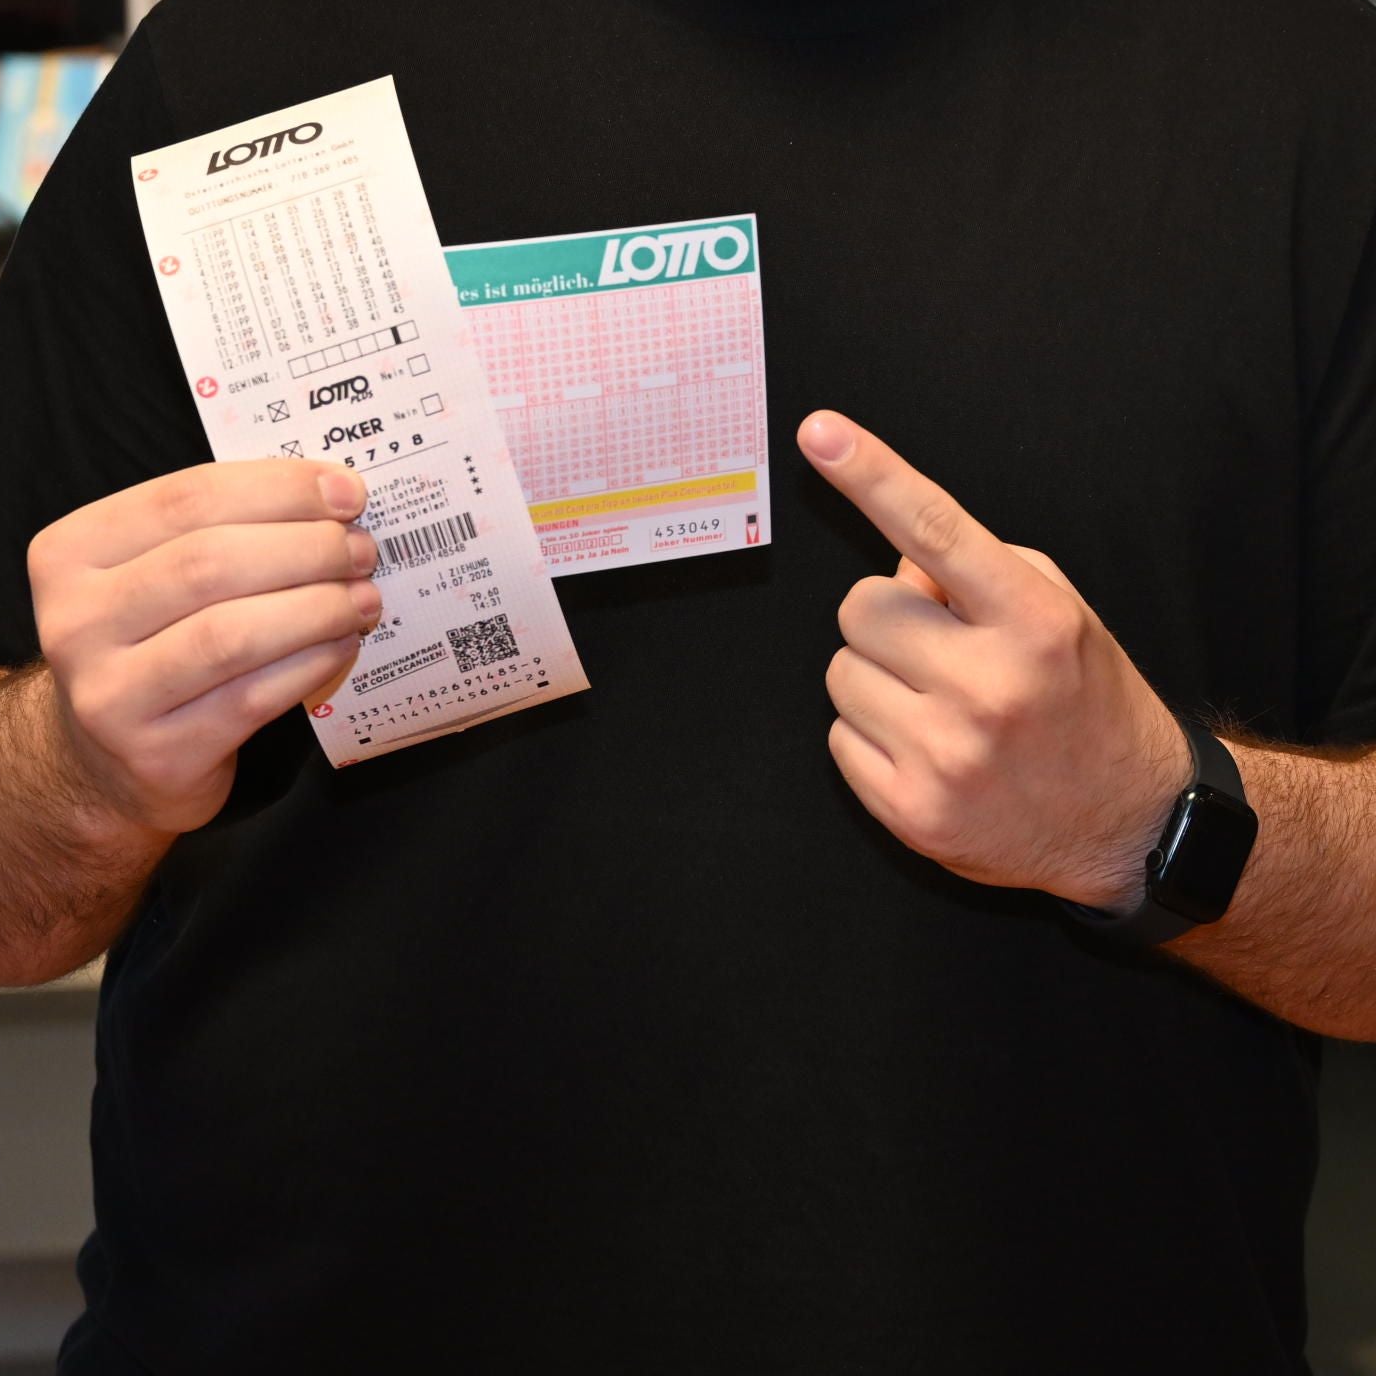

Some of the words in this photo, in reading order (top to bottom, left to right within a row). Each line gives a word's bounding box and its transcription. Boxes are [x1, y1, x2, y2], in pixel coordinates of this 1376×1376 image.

[206, 121, 323, 174] LOTTO
[484, 282, 506, 299] ist
[512, 272, 593, 296] möglich.
[598, 225, 749, 286] LOTTO
[253, 413, 264, 423] Ja
[309, 375, 370, 410] LOTTO
[379, 367, 403, 380] Nein
[350, 390, 373, 403] PLUS
[322, 417, 384, 451] JOKER
[393, 407, 417, 420] Nein
[366, 487, 445, 520] Gewinnchancen!
[369, 498, 385, 508] bei
[391, 477, 445, 500] LottoPlus.
[405, 497, 449, 520] spielen!
[654, 518, 720, 538] 453049
[654, 539, 679, 548] Joker
[682, 532, 722, 543] Nummer
[436, 568, 492, 591] 19.07.2026
[448, 557, 489, 576] ZIEHUNG
[473, 596, 501, 610] 14:31
[392, 616, 403, 627] €
[351, 671, 370, 685] ZUR
[369, 641, 444, 677] GEWINNABFRAGE
[354, 680, 369, 693] QR
[370, 670, 396, 686] CODE
[397, 648, 447, 676] SCANNEN!
